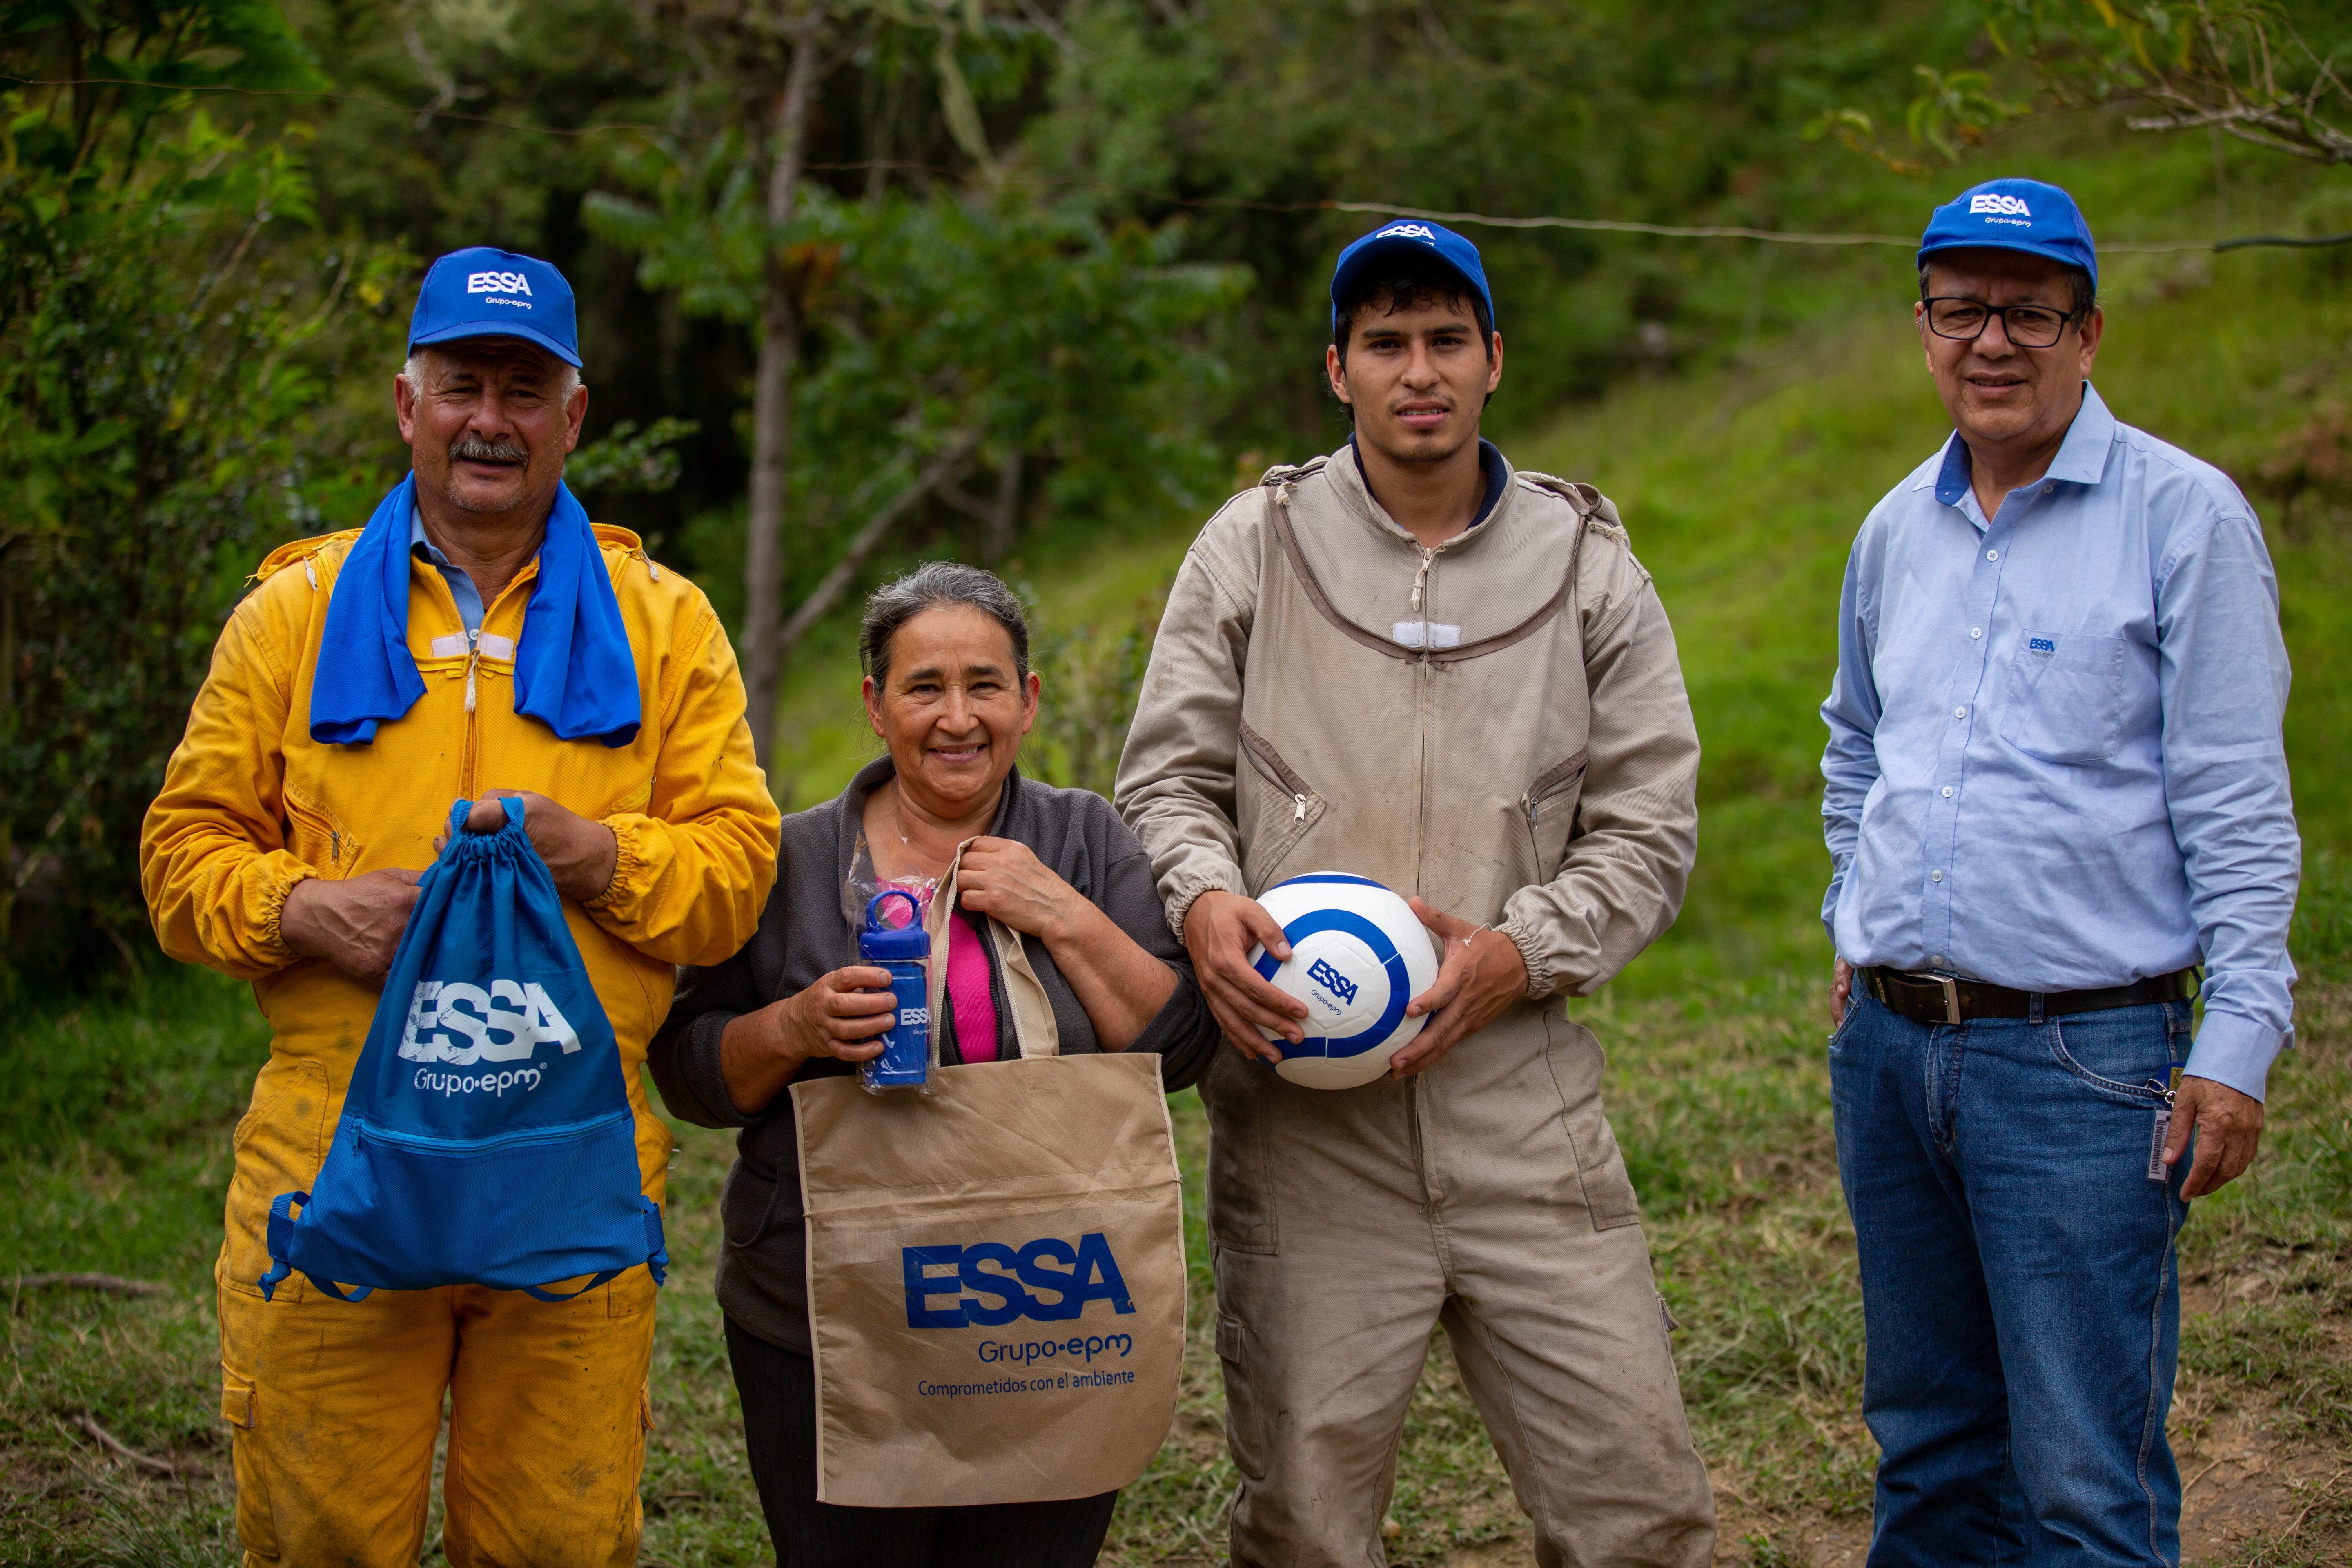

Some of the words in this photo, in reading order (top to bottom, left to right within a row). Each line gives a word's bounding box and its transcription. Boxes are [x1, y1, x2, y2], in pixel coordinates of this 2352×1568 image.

[1969, 194, 2031, 217] ESSA
[468, 272, 533, 297] ESSA
[2029, 638, 2054, 652] ESSA
[1306, 958, 1359, 1006] ESSA
[397, 979, 582, 1065] ESSA
[901, 1007, 931, 1025] ESSA
[902, 1232, 1136, 1328] ESSA
[918, 1377, 1026, 1399] Comprometidos
[1030, 1376, 1054, 1391] con
[1058, 1372, 1069, 1388] el
[1072, 1369, 1134, 1388] ambiente
